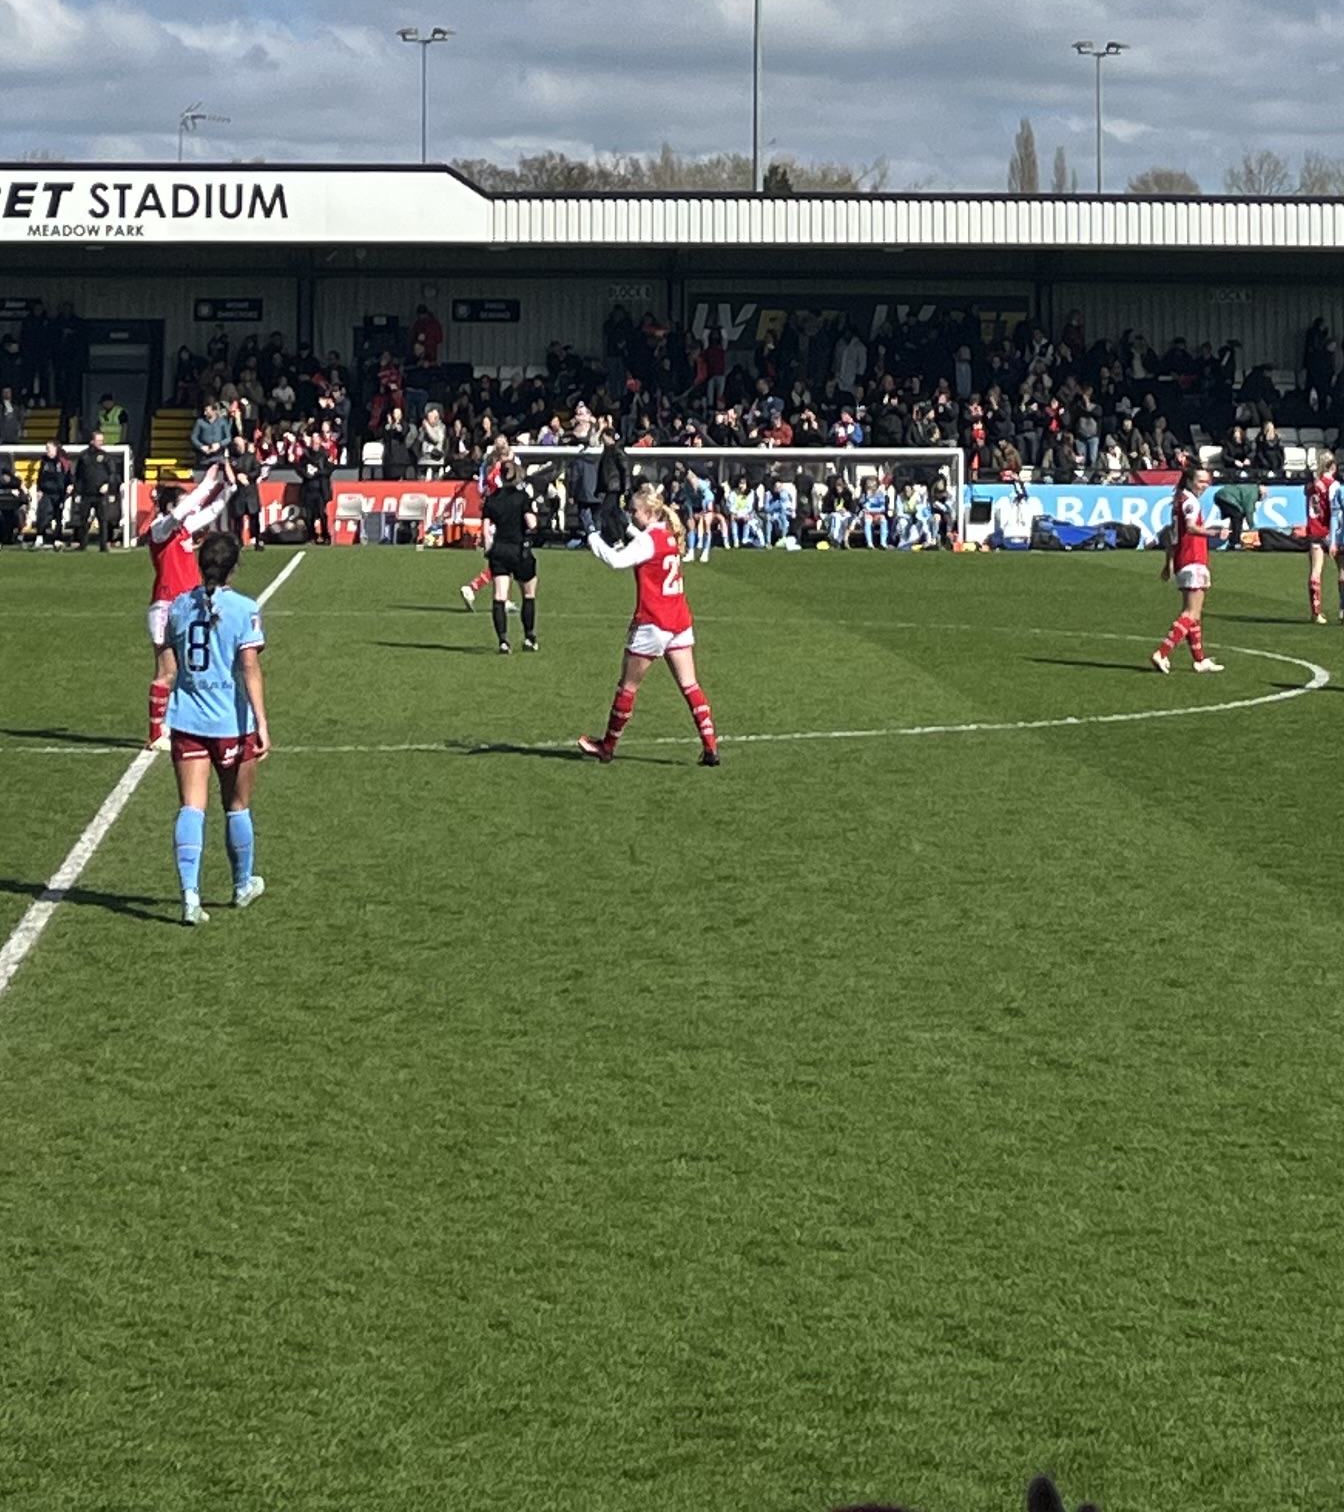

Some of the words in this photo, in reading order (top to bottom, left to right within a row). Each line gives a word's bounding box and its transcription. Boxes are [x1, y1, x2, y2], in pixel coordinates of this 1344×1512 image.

[89, 182, 289, 219] STADIUM
[27, 224, 101, 237] MEADOW
[106, 224, 145, 237] PARK
[187, 620, 210, 672] 8
